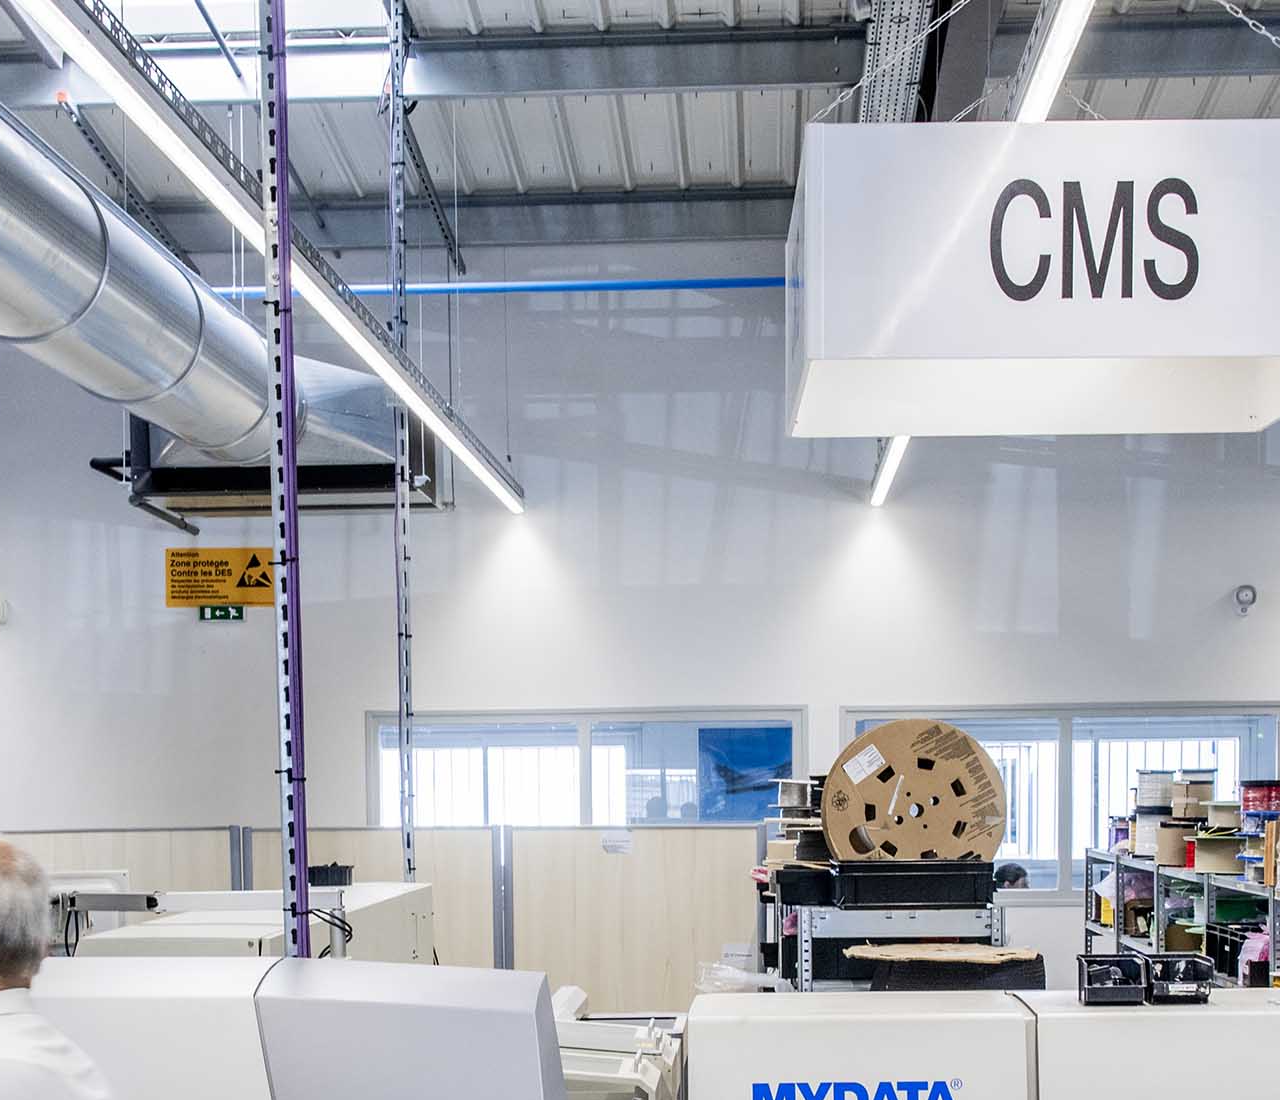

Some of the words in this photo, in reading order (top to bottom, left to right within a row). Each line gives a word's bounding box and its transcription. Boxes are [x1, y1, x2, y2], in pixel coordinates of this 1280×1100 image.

[990, 177, 1199, 302] CMS
[170, 560, 191, 568] Zone
[193, 559, 229, 569] protégée
[171, 569, 198, 577] Contre
[201, 569, 213, 577] les
[215, 569, 233, 577] DES
